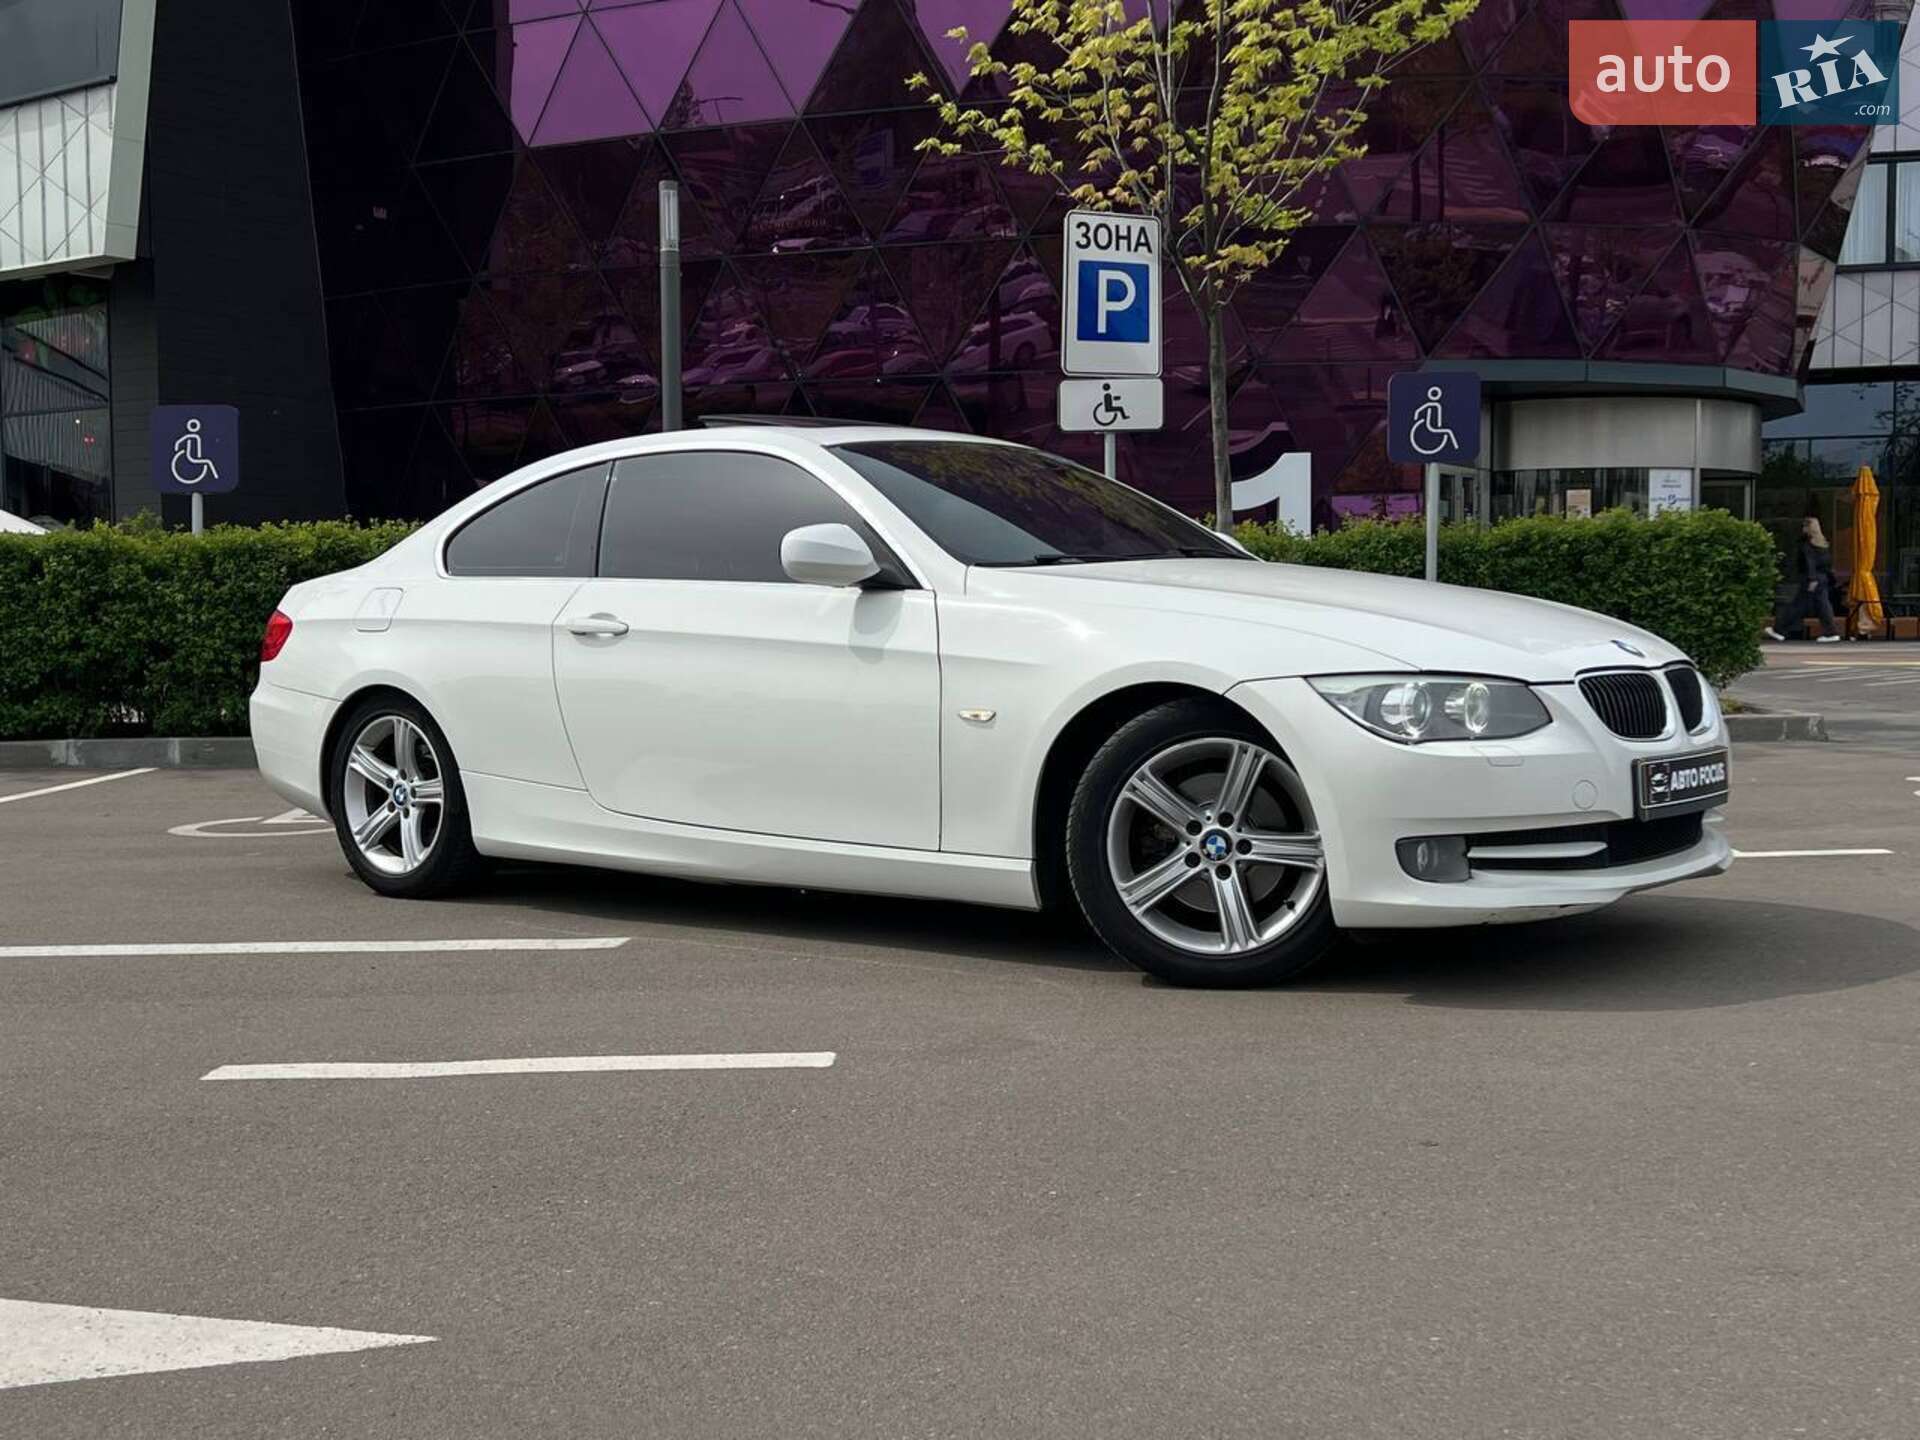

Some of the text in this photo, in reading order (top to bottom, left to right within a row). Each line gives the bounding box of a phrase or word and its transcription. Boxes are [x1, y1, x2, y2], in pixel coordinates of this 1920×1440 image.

[1075, 221, 1153, 254] ЗОНА
[1097, 269, 1136, 334] P
[1231, 452, 1312, 539] 1
